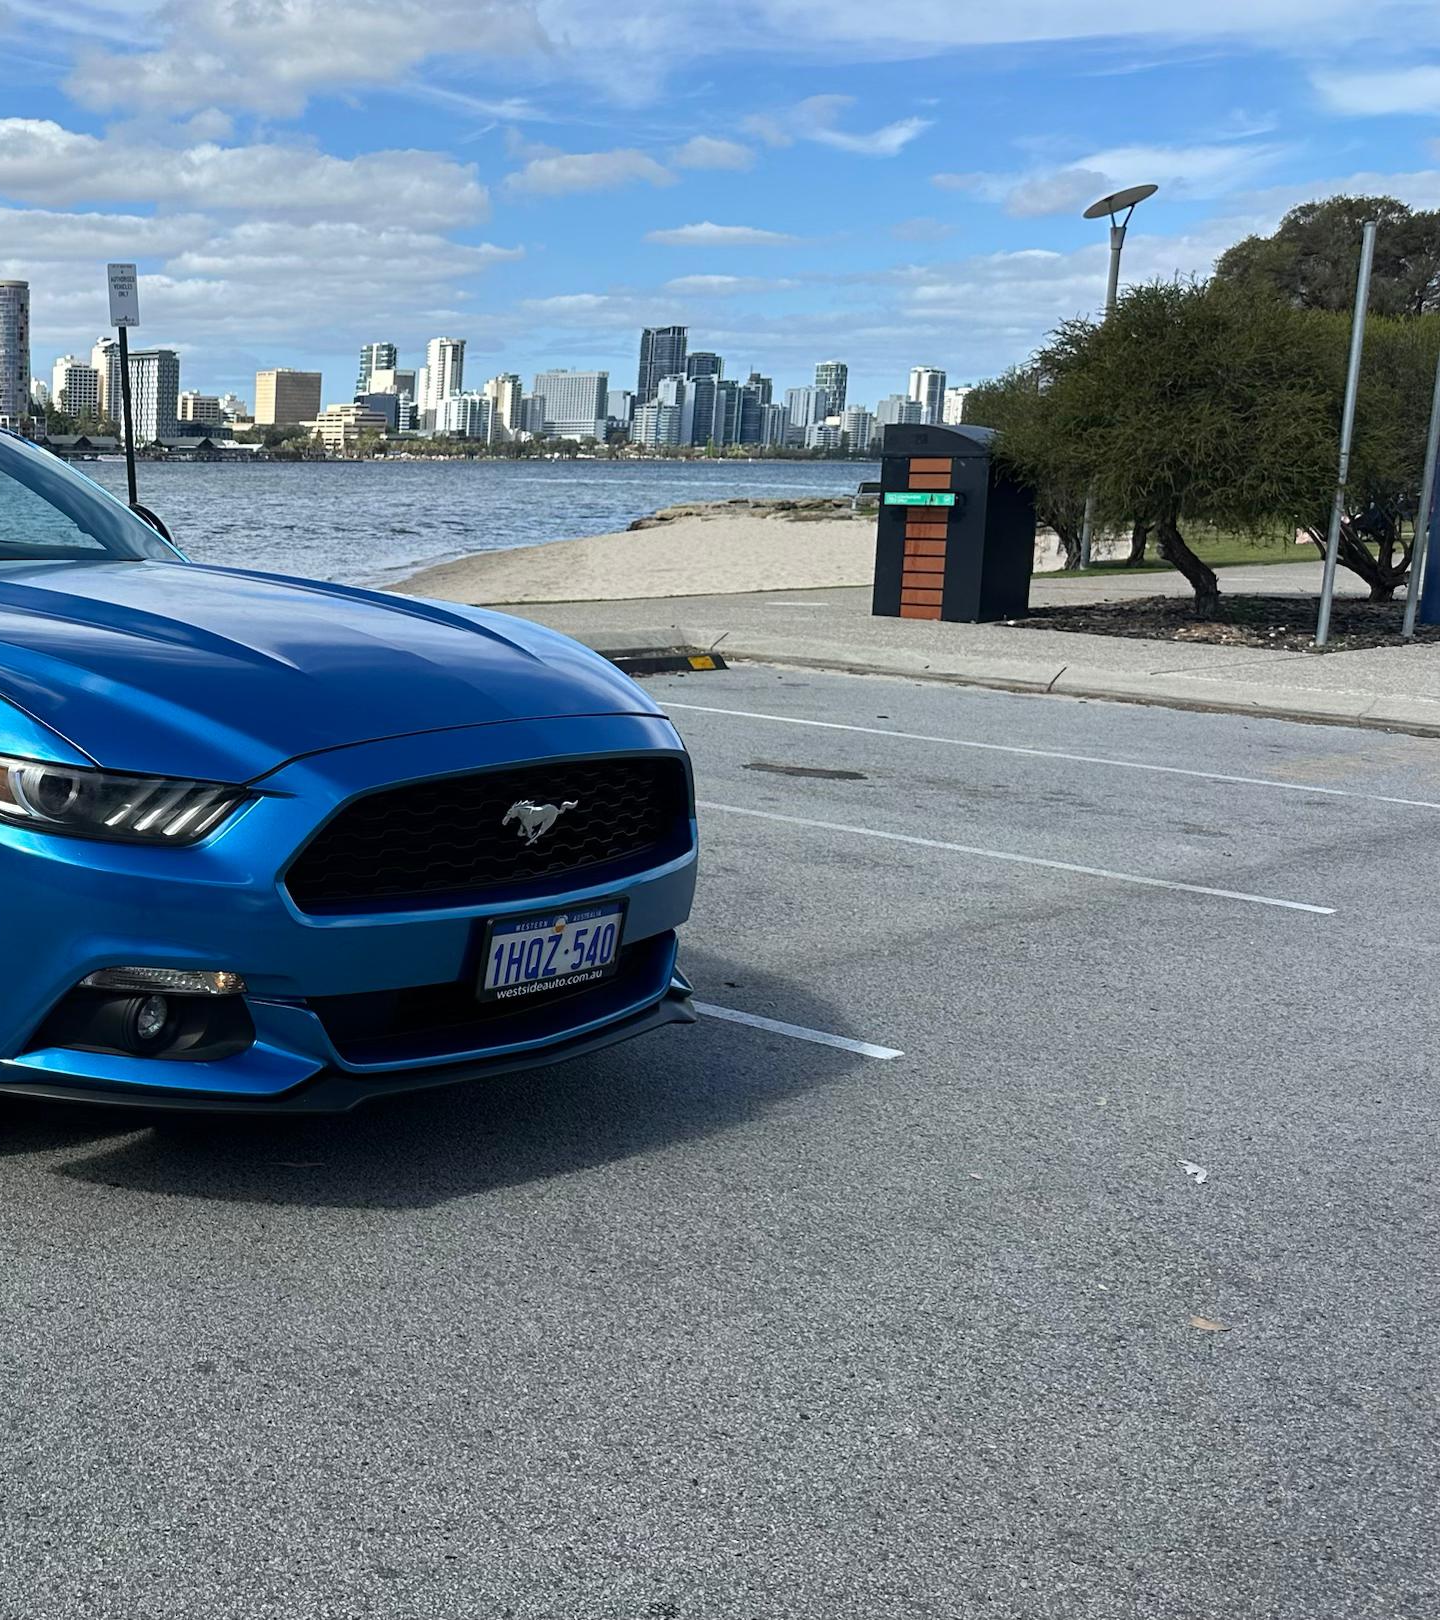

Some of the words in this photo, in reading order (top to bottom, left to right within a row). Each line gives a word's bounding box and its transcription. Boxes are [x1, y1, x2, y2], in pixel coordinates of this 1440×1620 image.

[515, 921, 548, 932] WESTERN
[572, 910, 602, 922] AUSTRALIA
[496, 969, 603, 999] westsideauto.com.au
